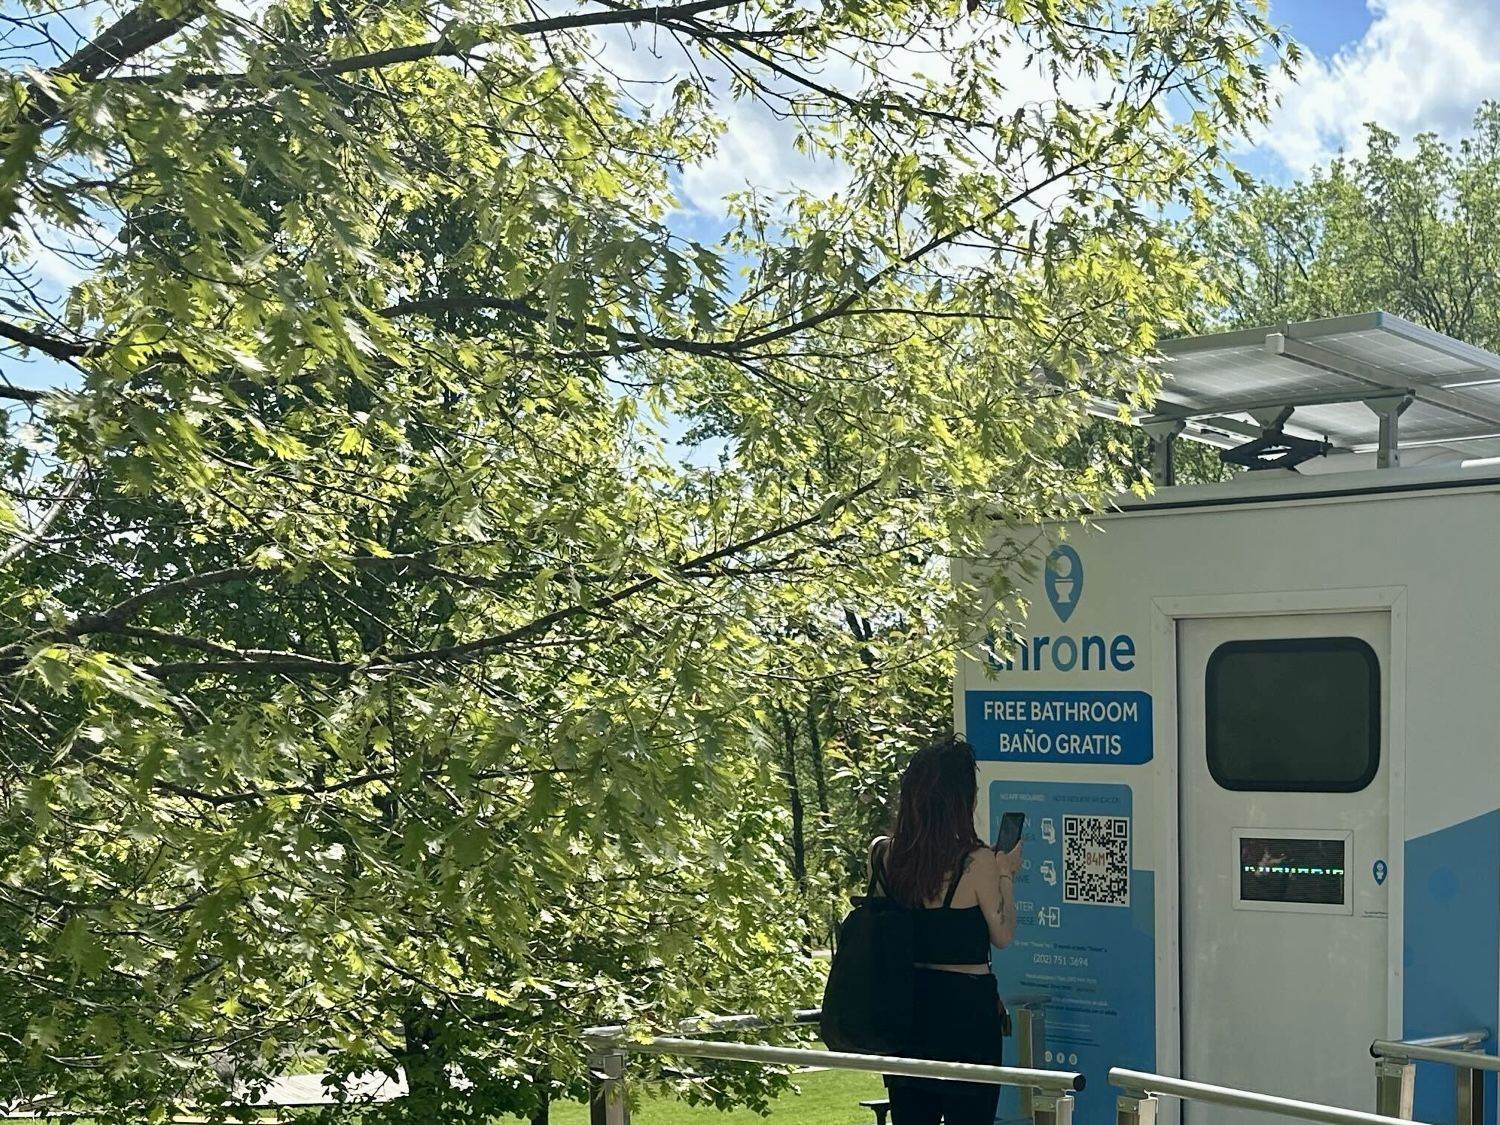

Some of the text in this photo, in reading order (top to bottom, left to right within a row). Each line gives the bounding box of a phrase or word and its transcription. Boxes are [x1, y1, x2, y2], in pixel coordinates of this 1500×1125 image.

[984, 701, 1138, 723] FREE BATHROOM
[1000, 728, 1122, 755] BAÑO GRATIS
